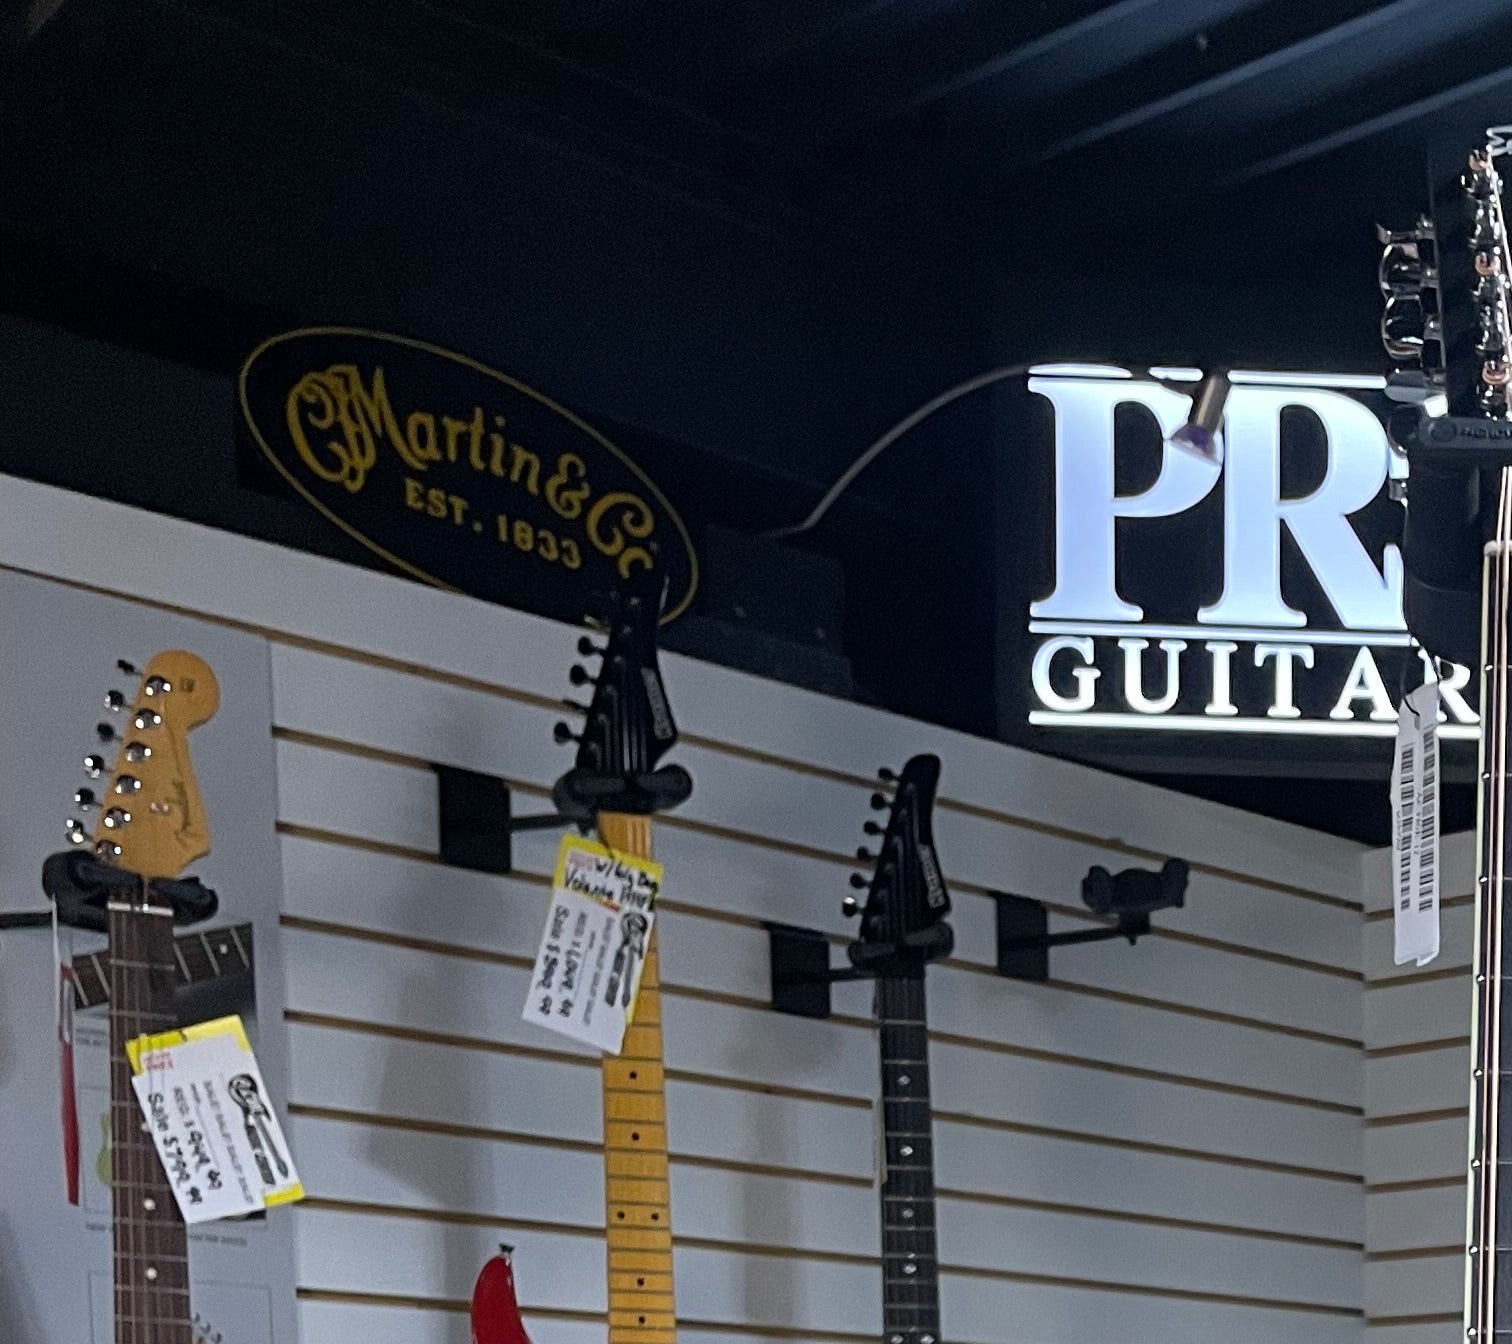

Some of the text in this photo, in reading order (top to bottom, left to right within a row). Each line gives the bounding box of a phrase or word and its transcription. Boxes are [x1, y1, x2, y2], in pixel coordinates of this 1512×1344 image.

[404, 477, 583, 571] EST. 1833
[1027, 372, 1406, 634] PR
[1030, 638, 1481, 726] GUITAR
